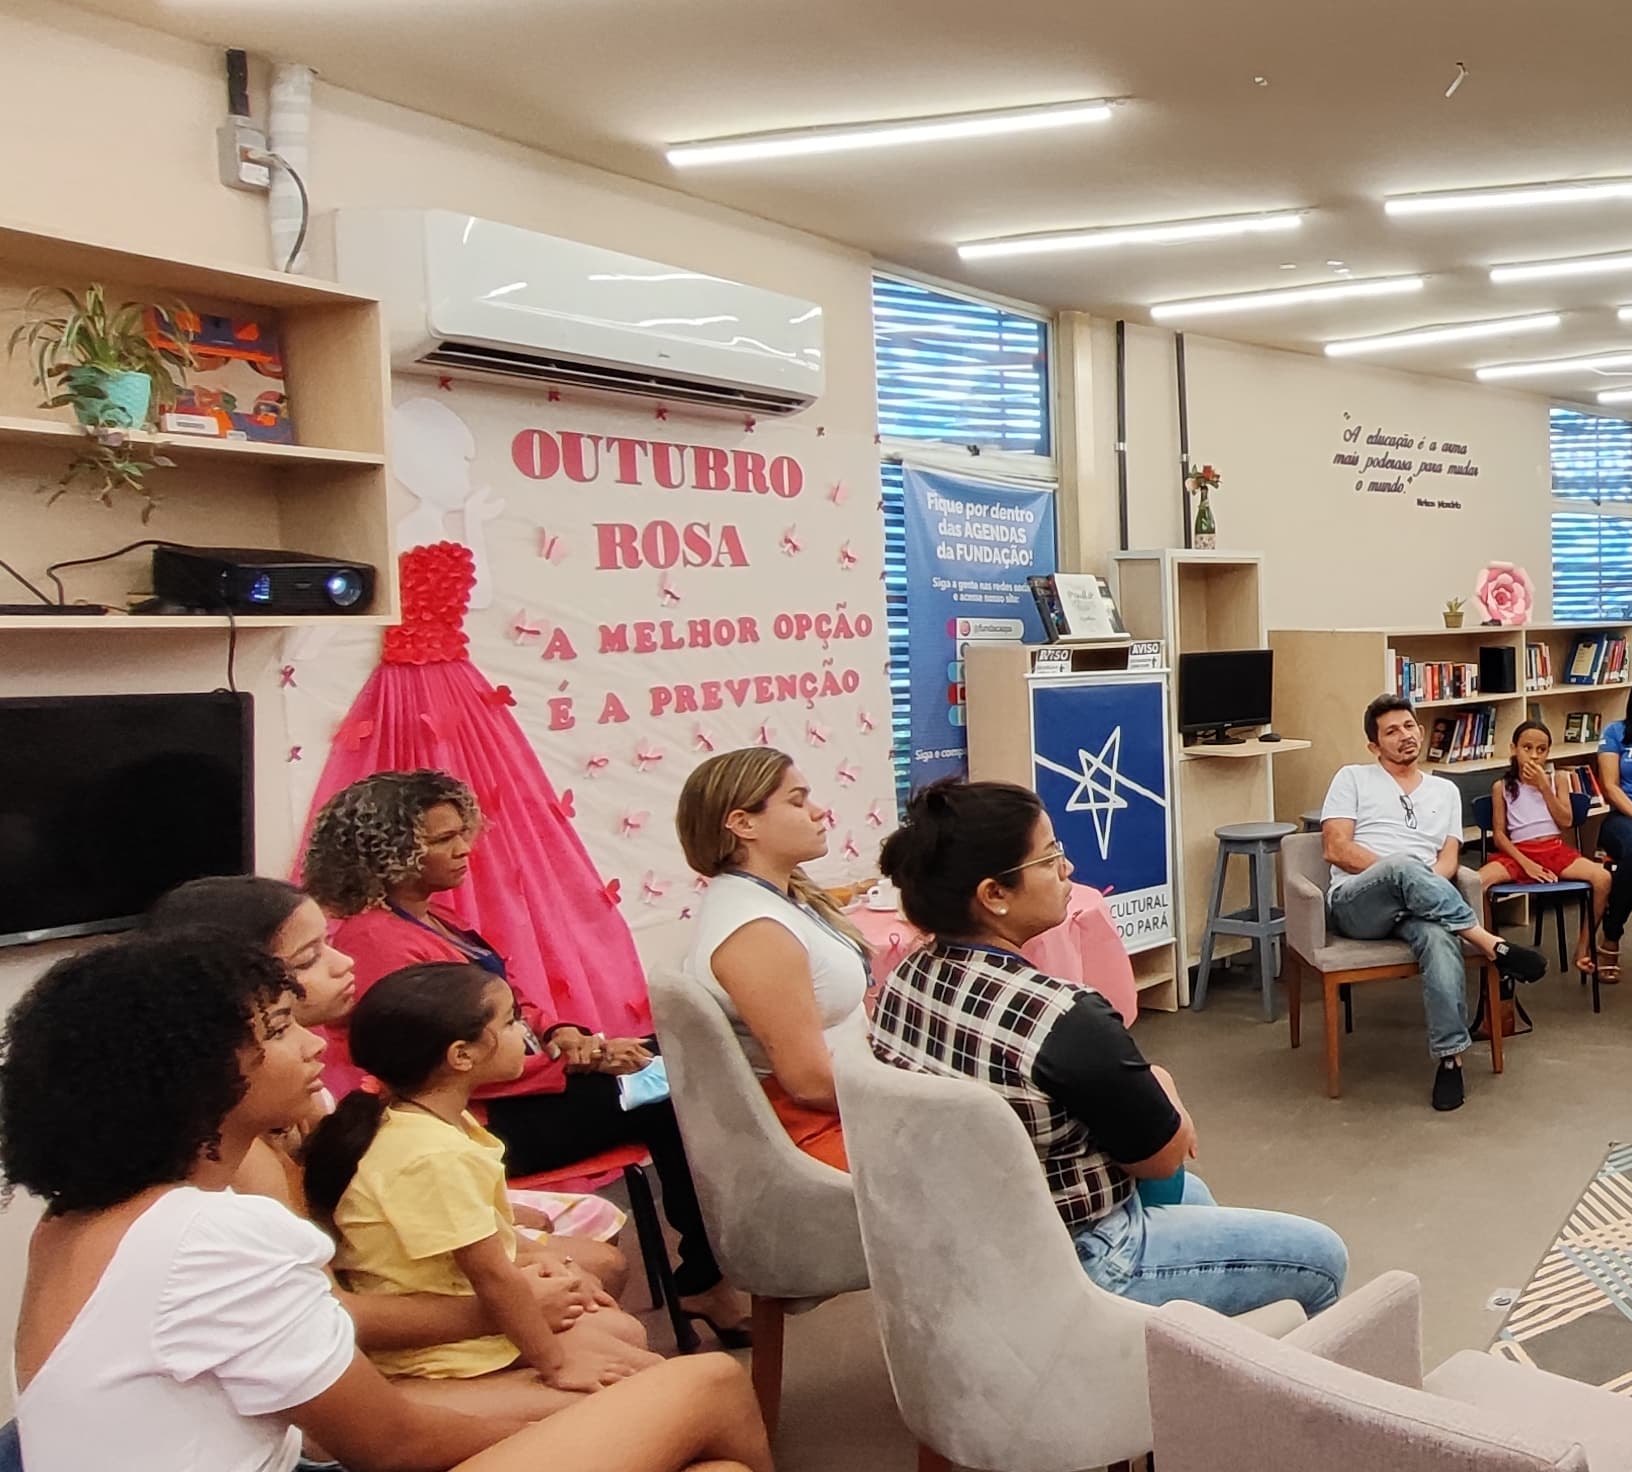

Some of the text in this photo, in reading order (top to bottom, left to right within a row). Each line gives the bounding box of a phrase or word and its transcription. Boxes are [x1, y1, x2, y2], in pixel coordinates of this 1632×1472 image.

[1366, 428, 1415, 450] educação
[1417, 436, 1427, 450] é
[1429, 441, 1437, 452] a
[1440, 442, 1468, 455] arma
[511, 428, 803, 498] OUTUBRO
[1332, 451, 1479, 477] mais poderosa para mudar
[1355, 480, 1363, 491] o
[927, 491, 1034, 523] Fique por dentro
[592, 519, 750, 570] ROSA
[938, 518, 1027, 544] das AGENDAS
[937, 542, 1033, 569] da FUNDAÇÃO!
[541, 602, 873, 661] A MELHOR OPÇÃO
[1132, 643, 1160, 655] AVISO
[547, 658, 860, 731] É A PREVENÇÃO
[1110, 893, 1168, 919] CULTURAL
[1137, 911, 1168, 935] PARÁ
